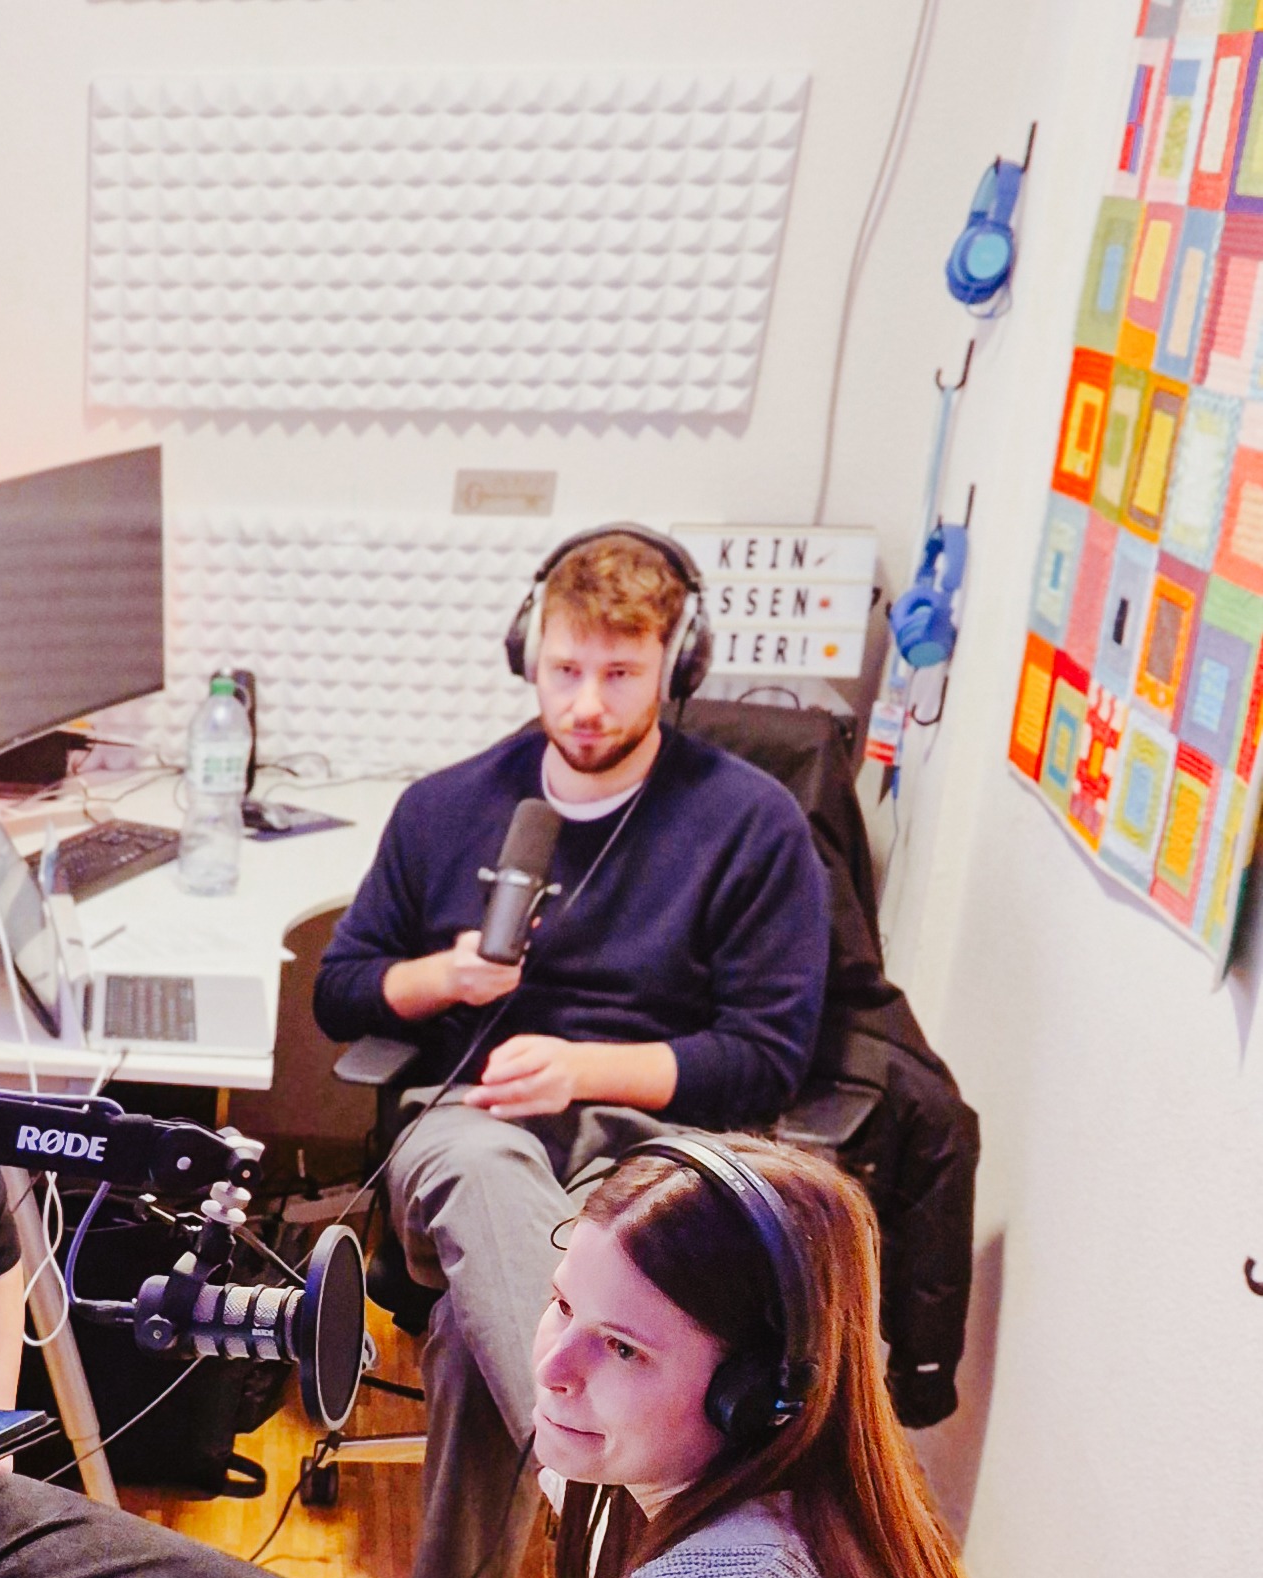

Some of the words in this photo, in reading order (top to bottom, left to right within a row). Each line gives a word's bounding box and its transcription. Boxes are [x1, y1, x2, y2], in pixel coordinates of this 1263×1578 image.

[719, 539, 808, 568] KEIN
[713, 635, 807, 665] IER!
[16, 1124, 108, 1163] RØDE
